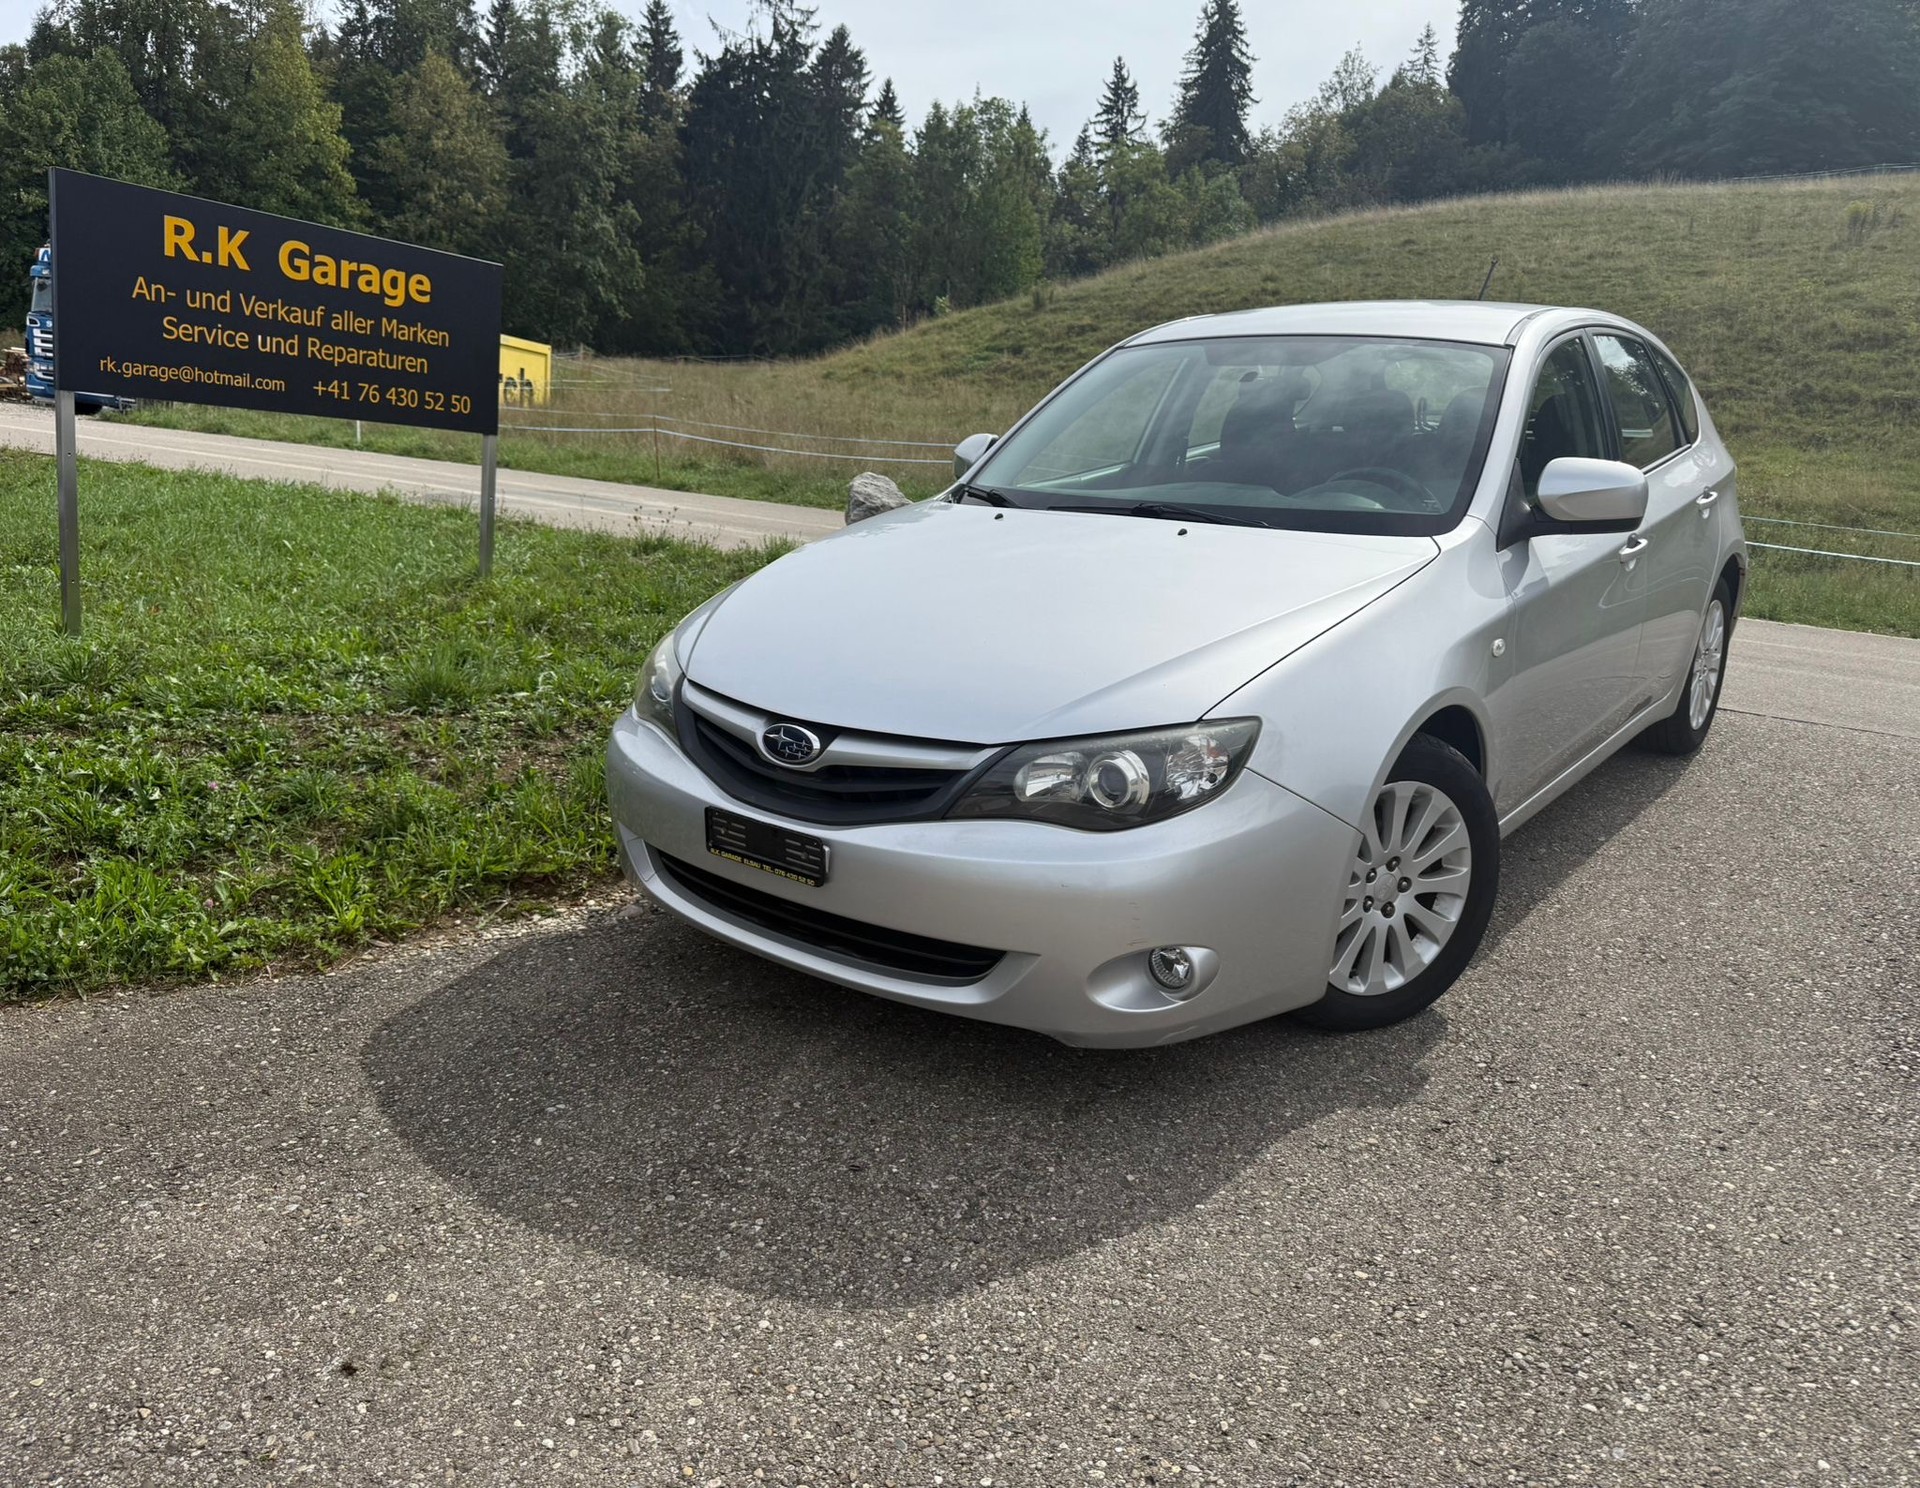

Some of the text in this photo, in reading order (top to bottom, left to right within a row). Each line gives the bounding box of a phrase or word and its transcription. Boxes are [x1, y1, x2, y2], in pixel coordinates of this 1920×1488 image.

[163, 215, 432, 308] R.K Garage
[132, 276, 449, 347] An- und Verkauf aller Marken
[100, 356, 285, 392] rk.garage@hotmail.com
[162, 315, 428, 374] Service und Reparaturen
[313, 380, 471, 414] +41 76 430 52 50
